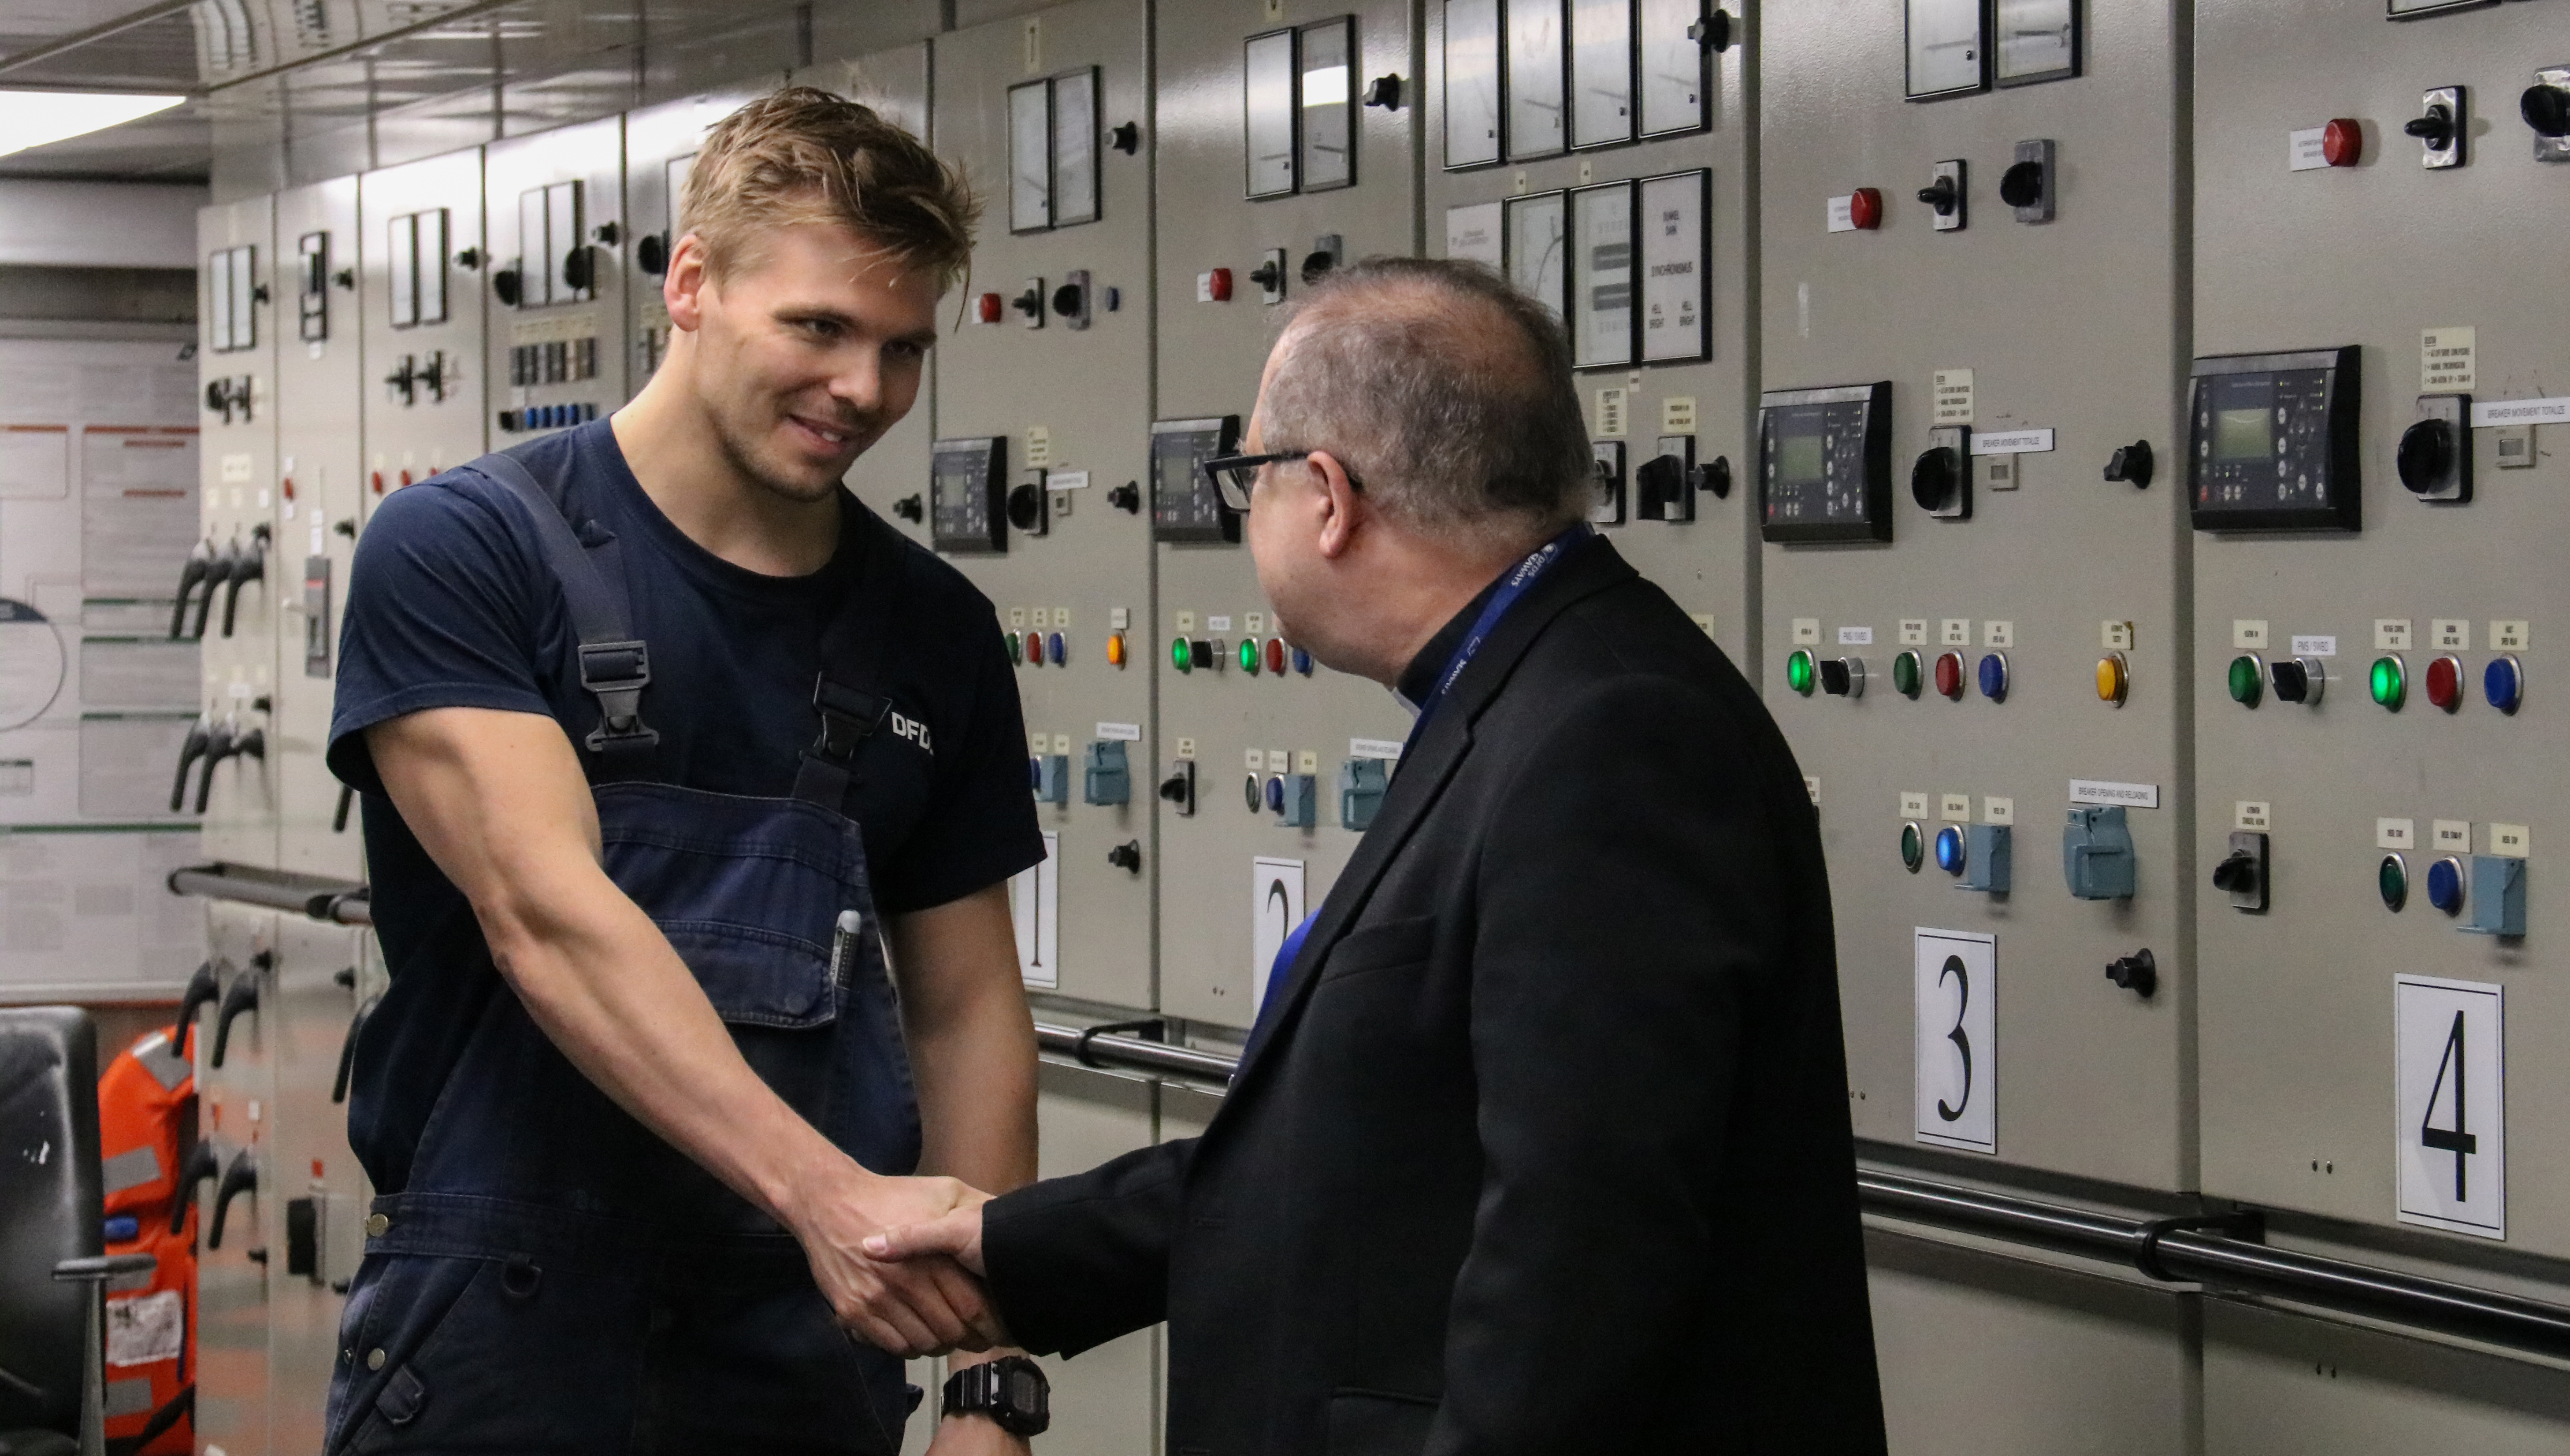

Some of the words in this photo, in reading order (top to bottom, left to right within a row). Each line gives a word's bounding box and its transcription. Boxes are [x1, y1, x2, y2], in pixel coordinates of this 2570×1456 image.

[1652, 261, 1692, 277] SYNCHRONISMUS
[2487, 408, 2510, 418] BREAKER
[2512, 407, 2540, 416] MOVEMENT
[1511, 553, 1539, 586] SEAWAYS
[891, 711, 934, 756] DFD
[2079, 787, 2096, 796] BREAKER
[2098, 789, 2115, 797] OPENING
[1937, 955, 1971, 1122] 3
[2421, 1010, 2476, 1202] 4
